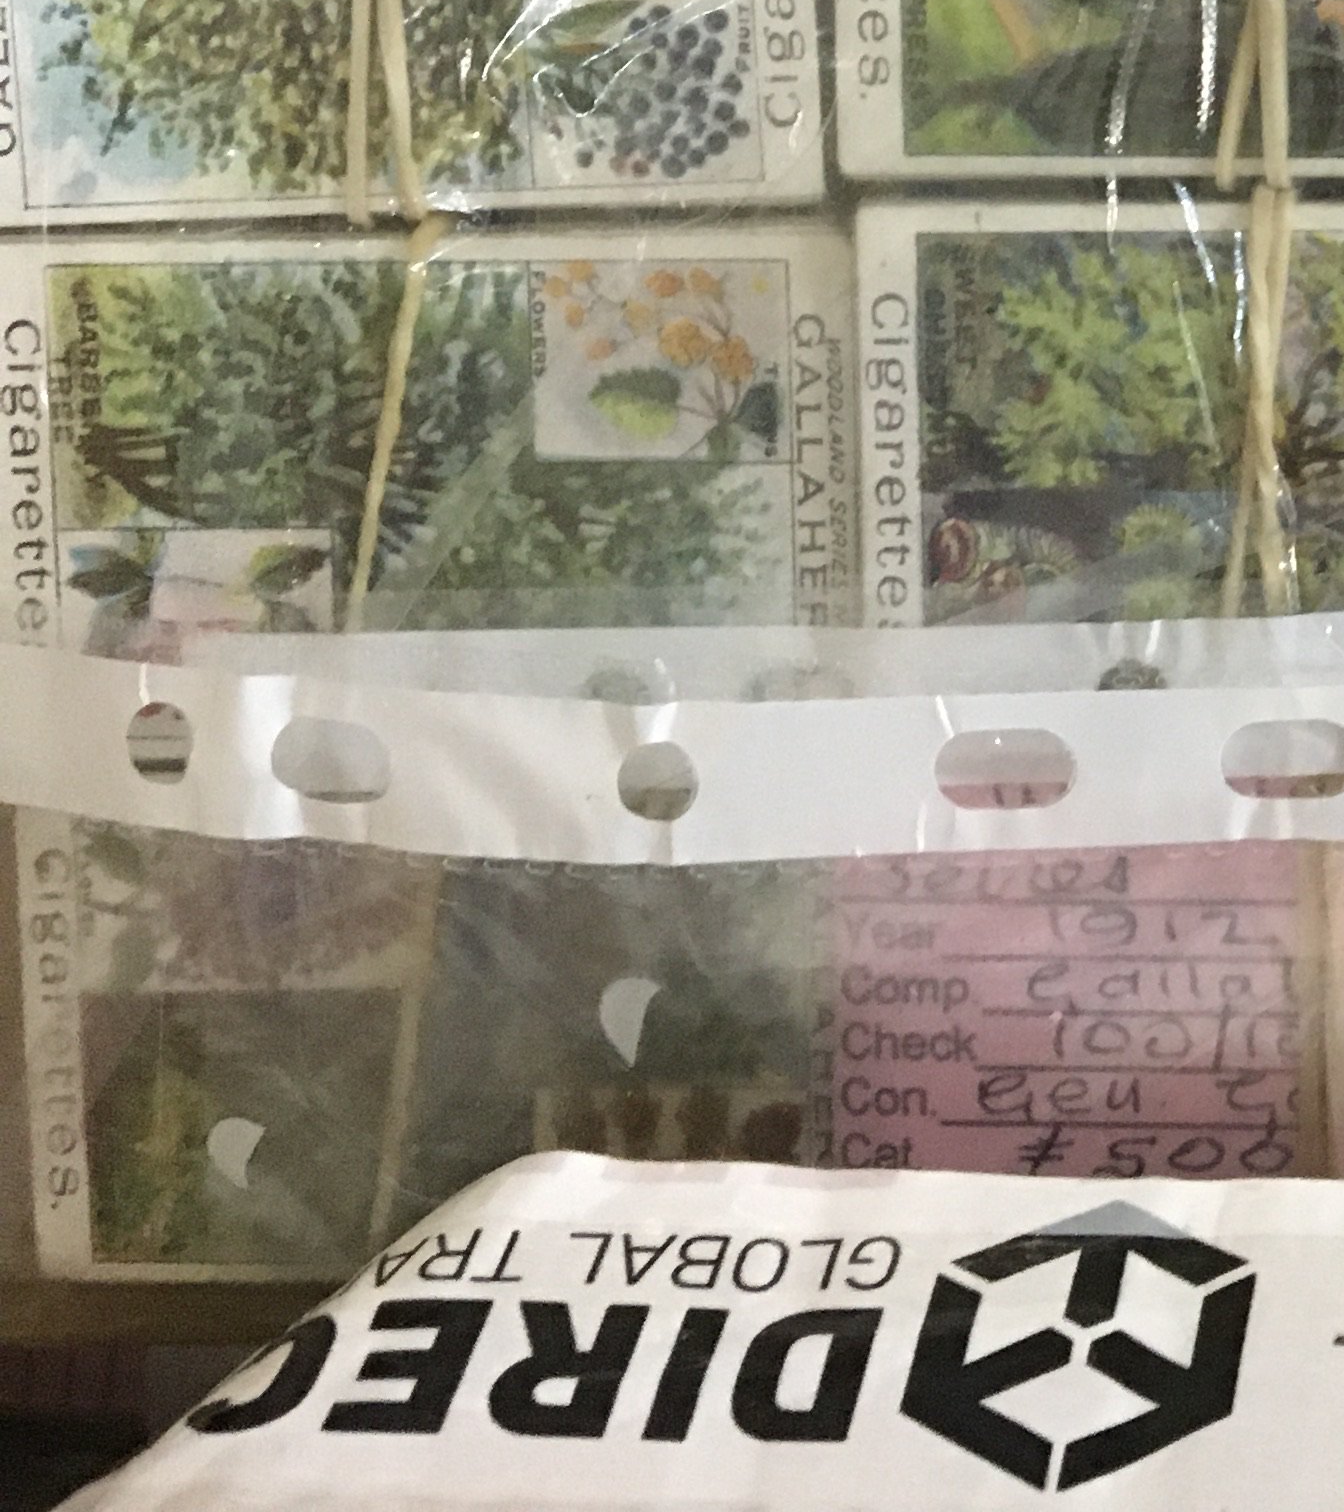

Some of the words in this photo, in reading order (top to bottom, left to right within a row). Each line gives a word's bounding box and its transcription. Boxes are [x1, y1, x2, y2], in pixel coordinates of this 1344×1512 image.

[733, 3, 752, 75] FRUIT
[529, 269, 547, 379] FLOWERS
[825, 337, 845, 484] WOODLAND
[31, 847, 80, 1213] Cigarettes.
[840, 1025, 977, 1062] Check
[840, 1080, 940, 1117] Con.
[569, 1229, 904, 1292] GLOBAL
